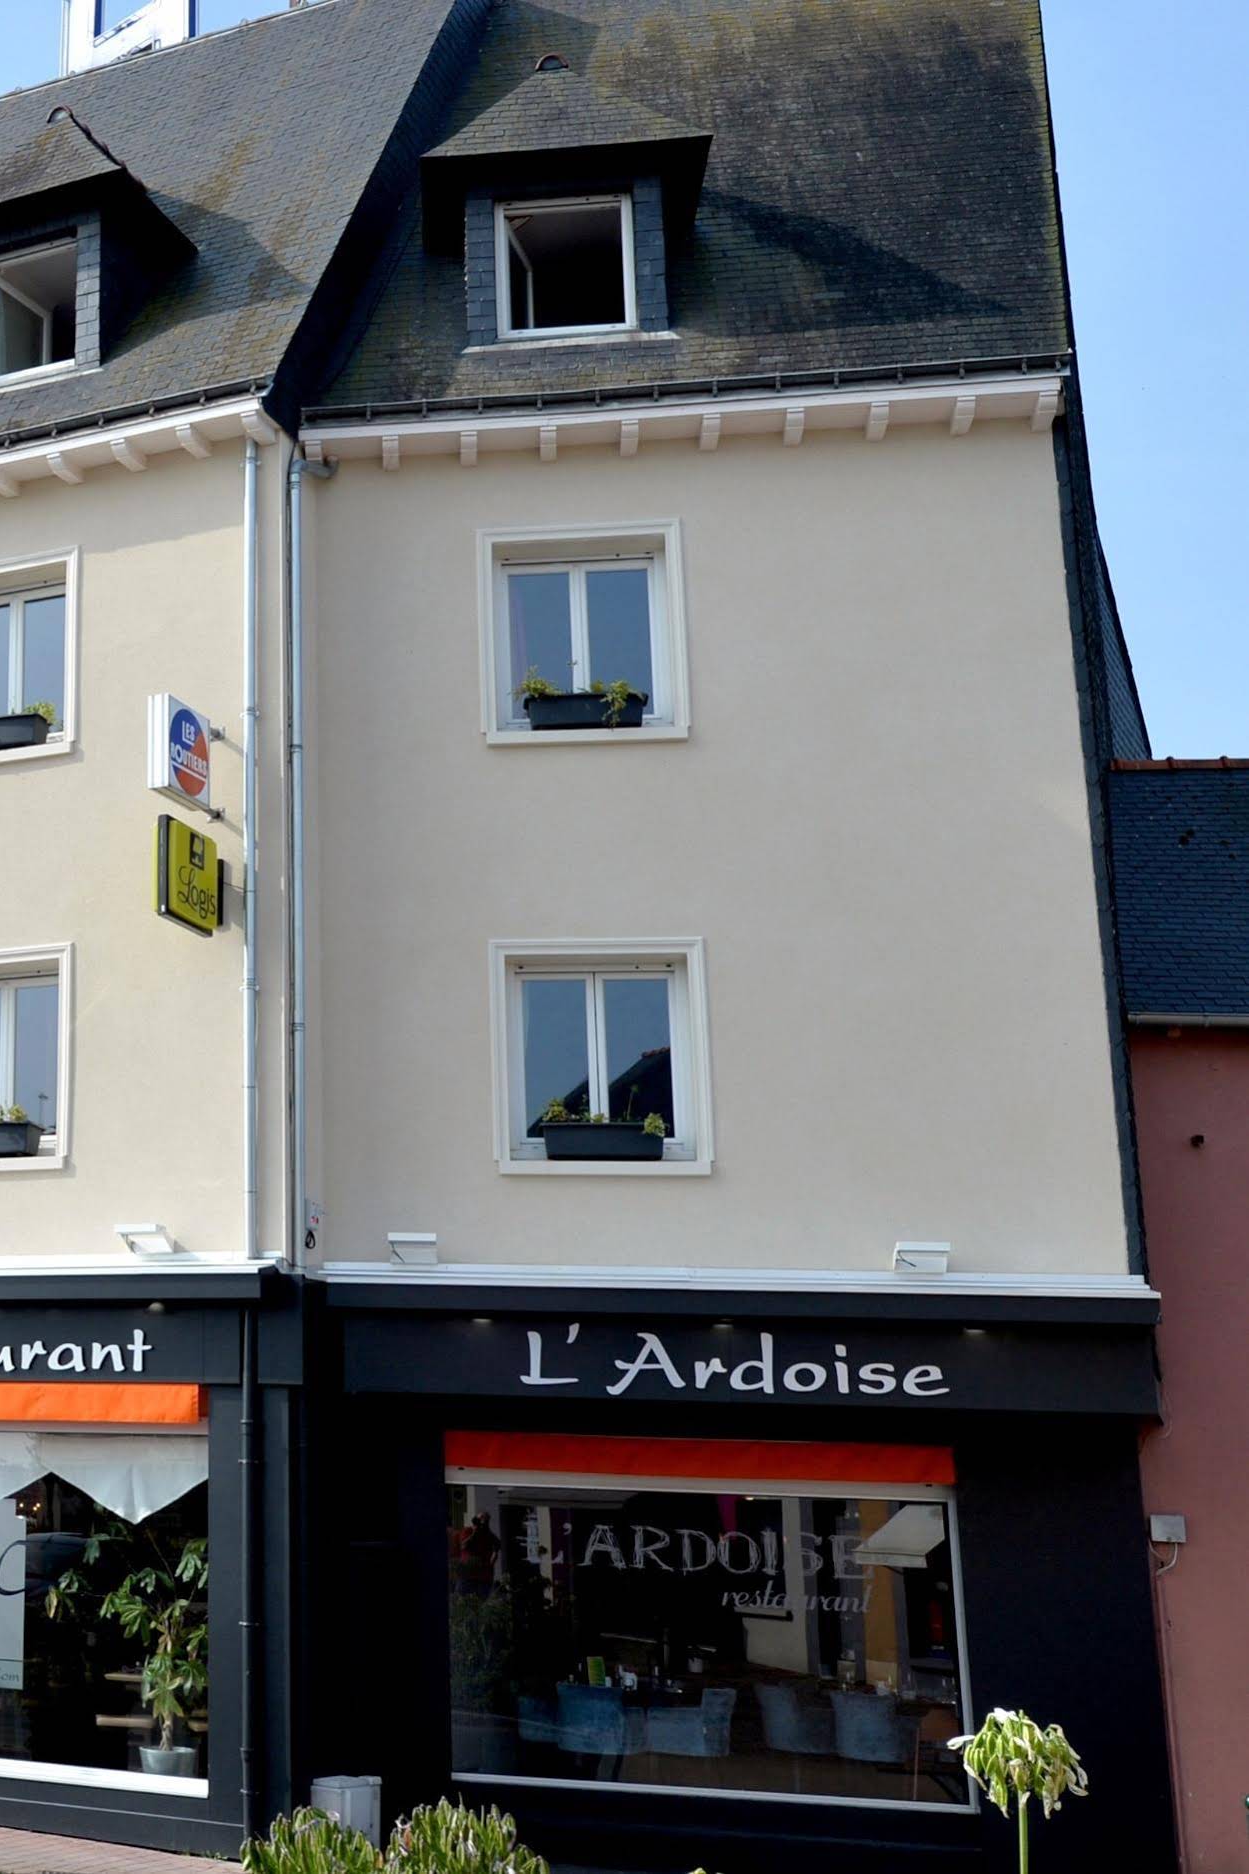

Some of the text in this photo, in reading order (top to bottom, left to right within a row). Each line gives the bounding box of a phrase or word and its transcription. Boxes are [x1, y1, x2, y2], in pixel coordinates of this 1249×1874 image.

[182, 720, 196, 745] LES
[177, 865, 216, 920] Logis
[515, 1508, 874, 1580] L'ARDOISE
